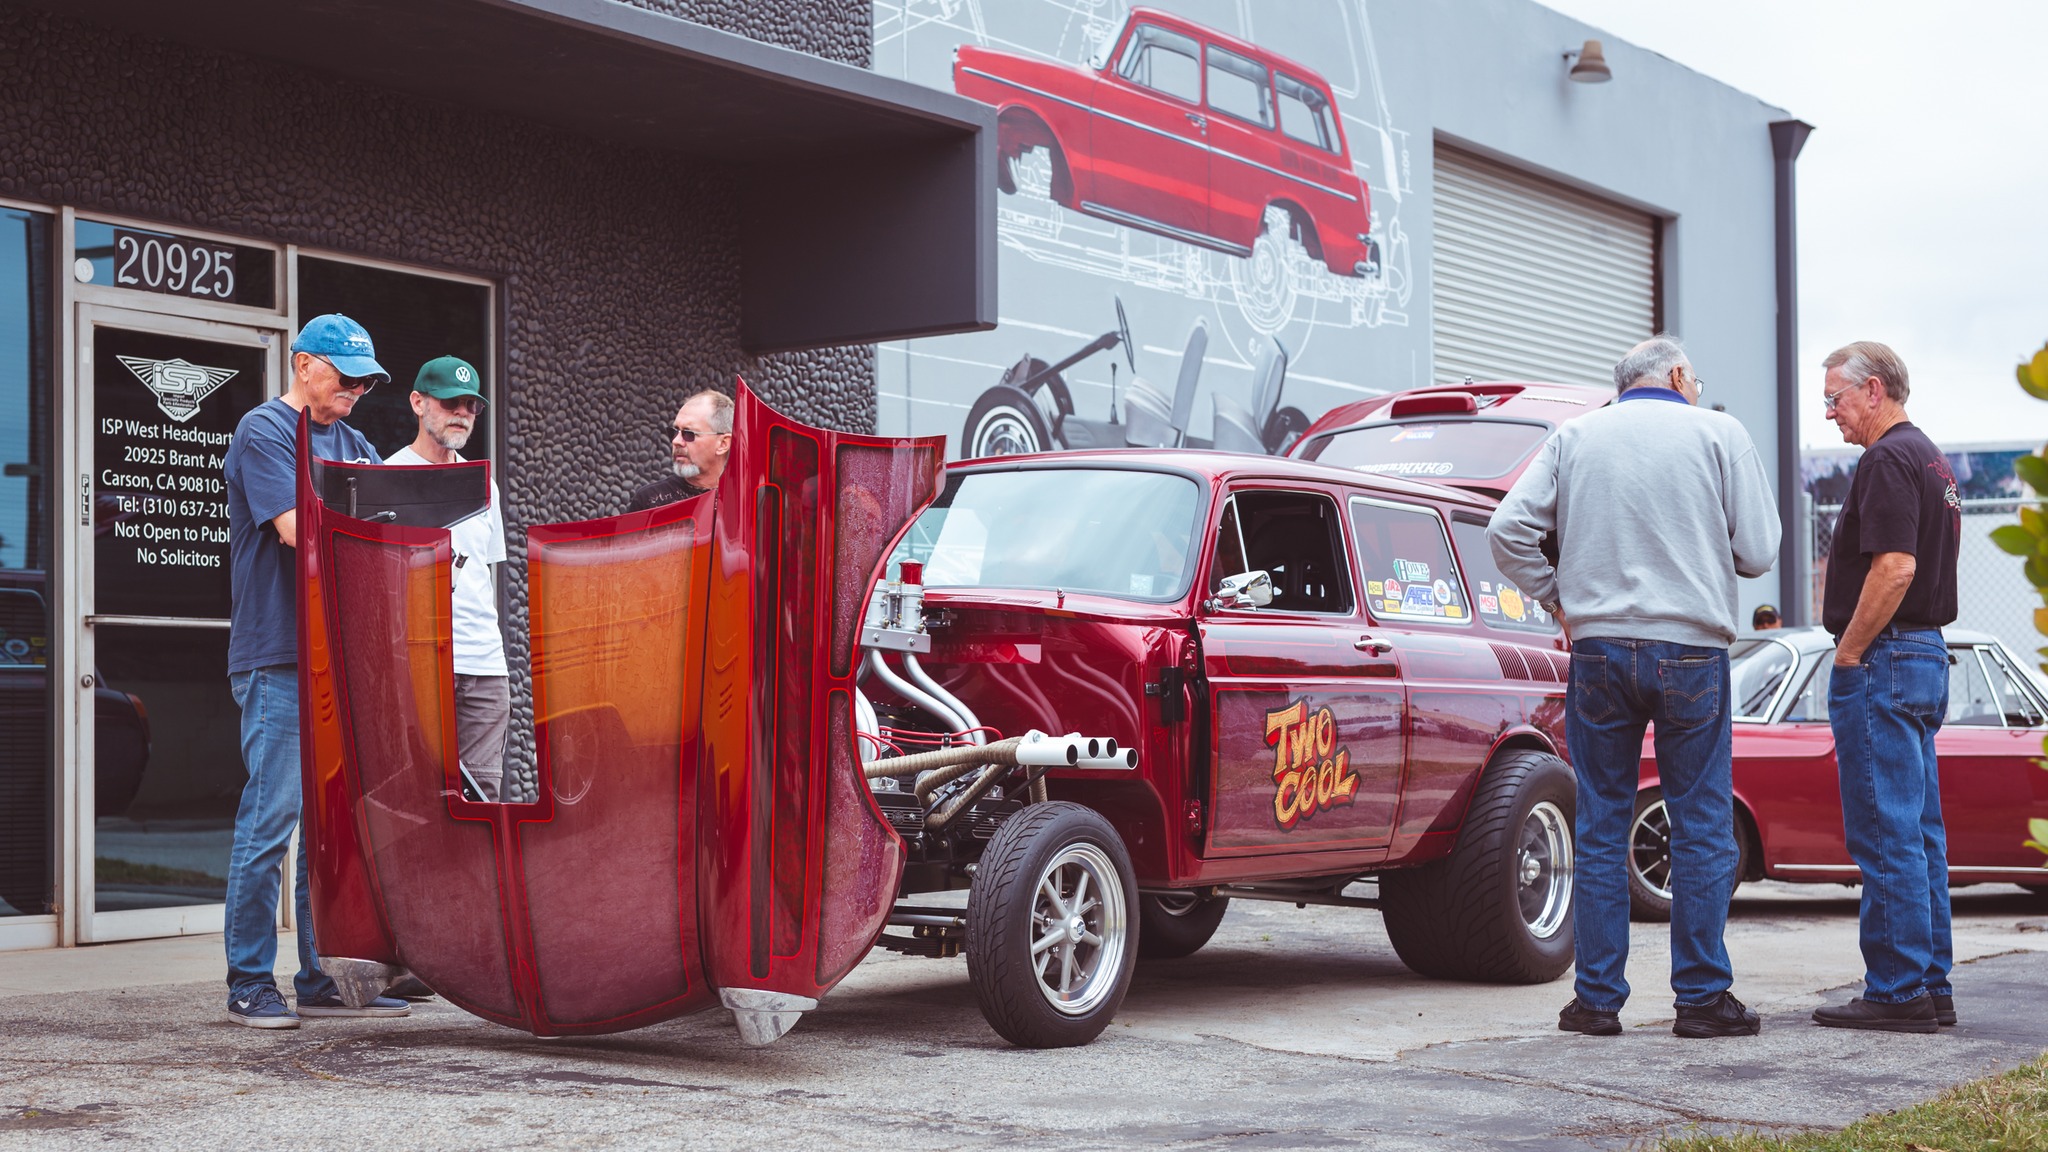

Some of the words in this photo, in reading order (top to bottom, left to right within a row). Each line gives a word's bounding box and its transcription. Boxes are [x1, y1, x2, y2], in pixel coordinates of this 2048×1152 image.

[117, 236, 235, 298] 20925
[102, 418, 123, 435] ISP
[125, 420, 159, 439] West
[163, 424, 234, 447] Headquart
[124, 446, 166, 464] 20925
[169, 450, 204, 468] Brant
[208, 454, 225, 469] Av
[102, 469, 153, 490] Carson,
[156, 474, 176, 490] CA
[179, 476, 228, 494] 90810-
[116, 496, 140, 513] Tel:
[142, 498, 176, 517] (310)
[114, 521, 140, 538] Not
[143, 523, 181, 542] Open
[184, 527, 198, 541] to
[201, 526, 230, 543] Publ
[137, 548, 157, 564] No
[160, 549, 220, 567] Solicitors
[1480, 596, 1496, 608] MSD
[1265, 700, 1336, 780] TWO
[1274, 750, 1360, 831] COOL
